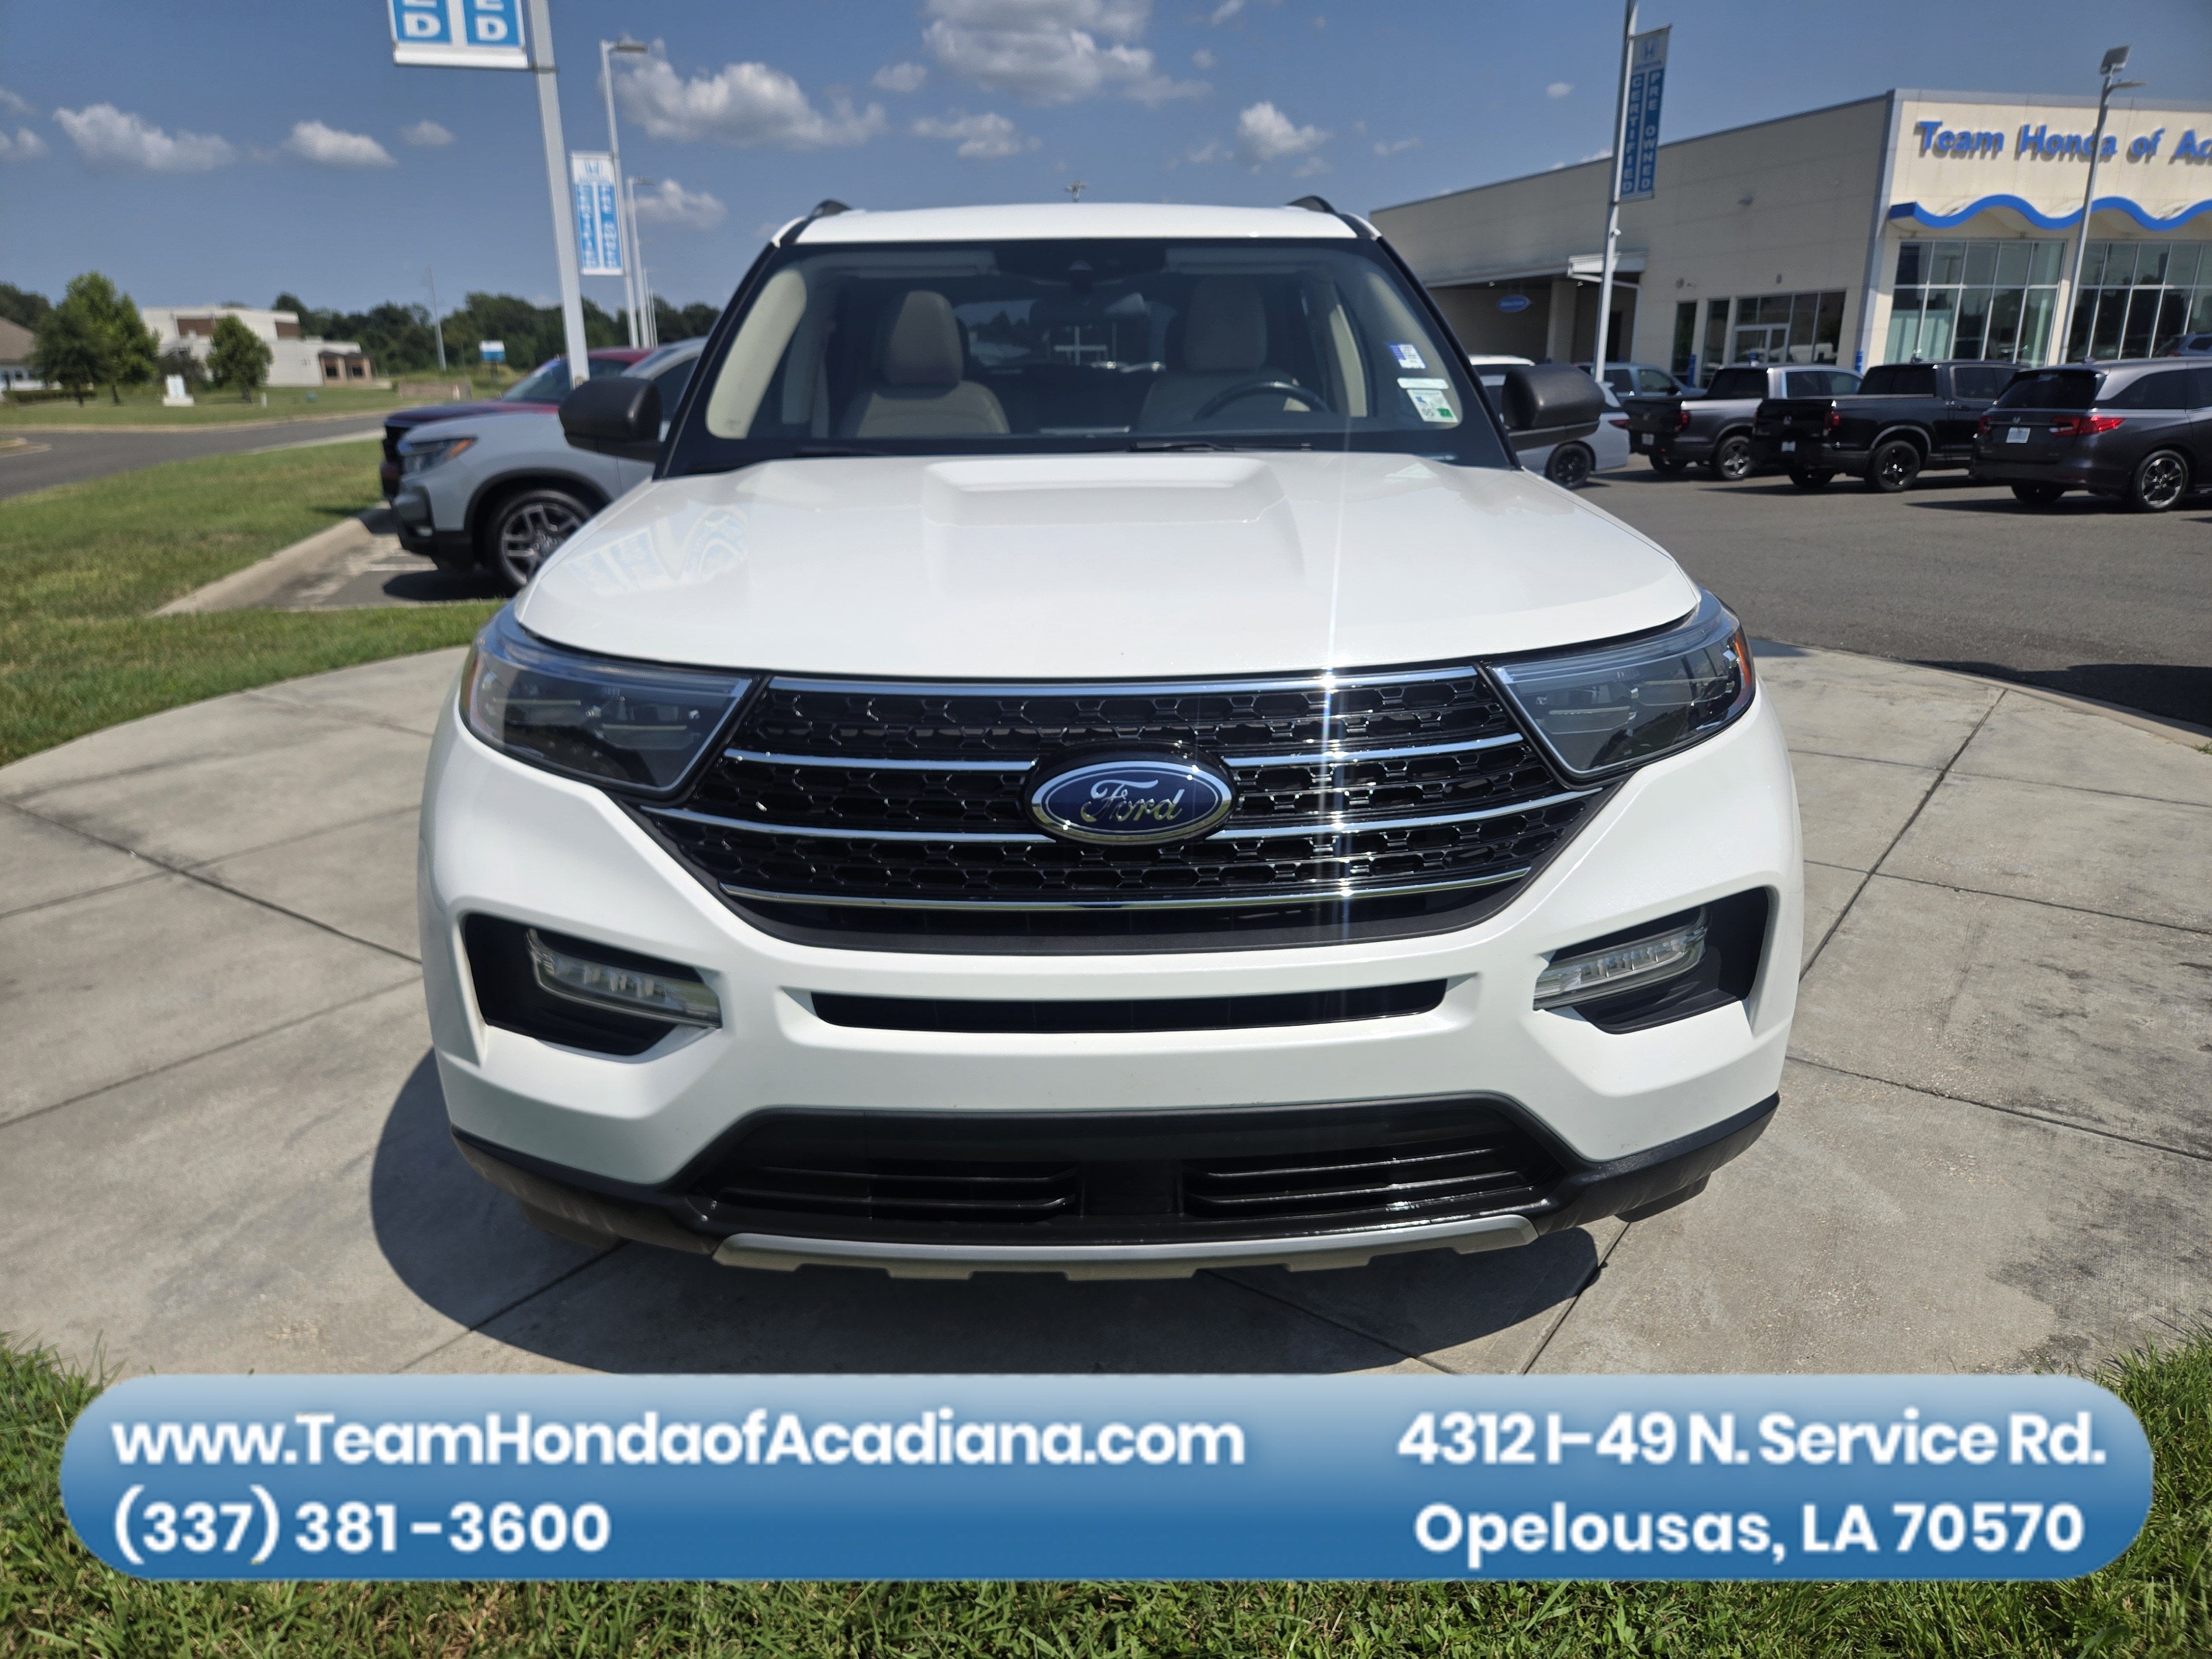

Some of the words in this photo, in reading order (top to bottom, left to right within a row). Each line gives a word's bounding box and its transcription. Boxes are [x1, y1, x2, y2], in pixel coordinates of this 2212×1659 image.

[1918, 121, 2005, 152] Team
[2132, 127, 2166, 156] of
[1080, 779, 1185, 822] Ford
